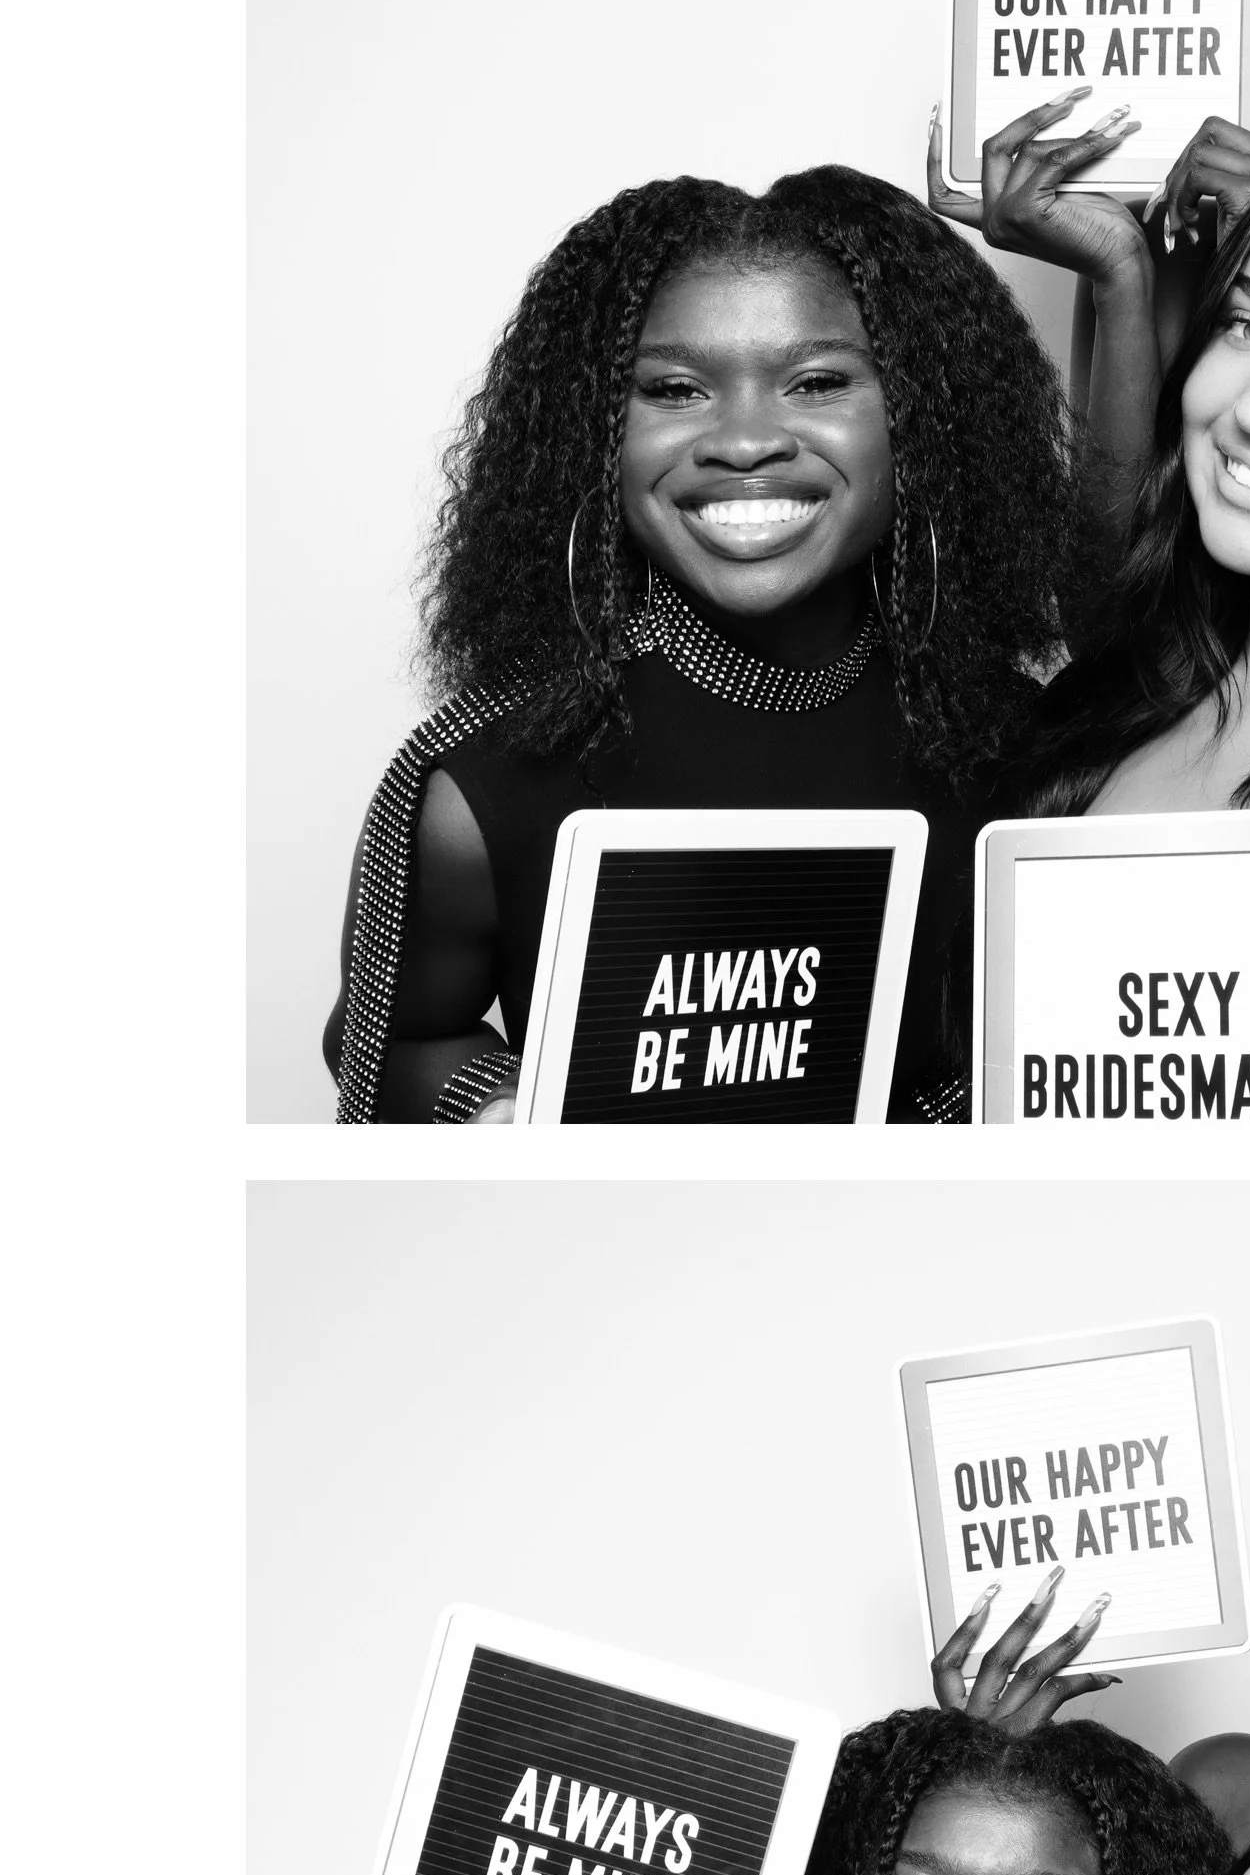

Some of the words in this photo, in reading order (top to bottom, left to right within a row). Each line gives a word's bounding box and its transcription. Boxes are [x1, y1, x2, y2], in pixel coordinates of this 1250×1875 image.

[993, 28, 1086, 77] EVER
[1101, 26, 1222, 76] AFTER
[642, 946, 821, 1017] ALWAYS
[1119, 971, 1241, 1038] SEXY
[630, 1028, 690, 1094] BE
[703, 1019, 812, 1087] MINE
[954, 1456, 1032, 1512] OUR
[1045, 1435, 1169, 1500] HAPPY
[961, 1514, 1059, 1573] EVER
[1075, 1496, 1194, 1558] AFTER
[501, 1767, 700, 1874] ALWAYS
